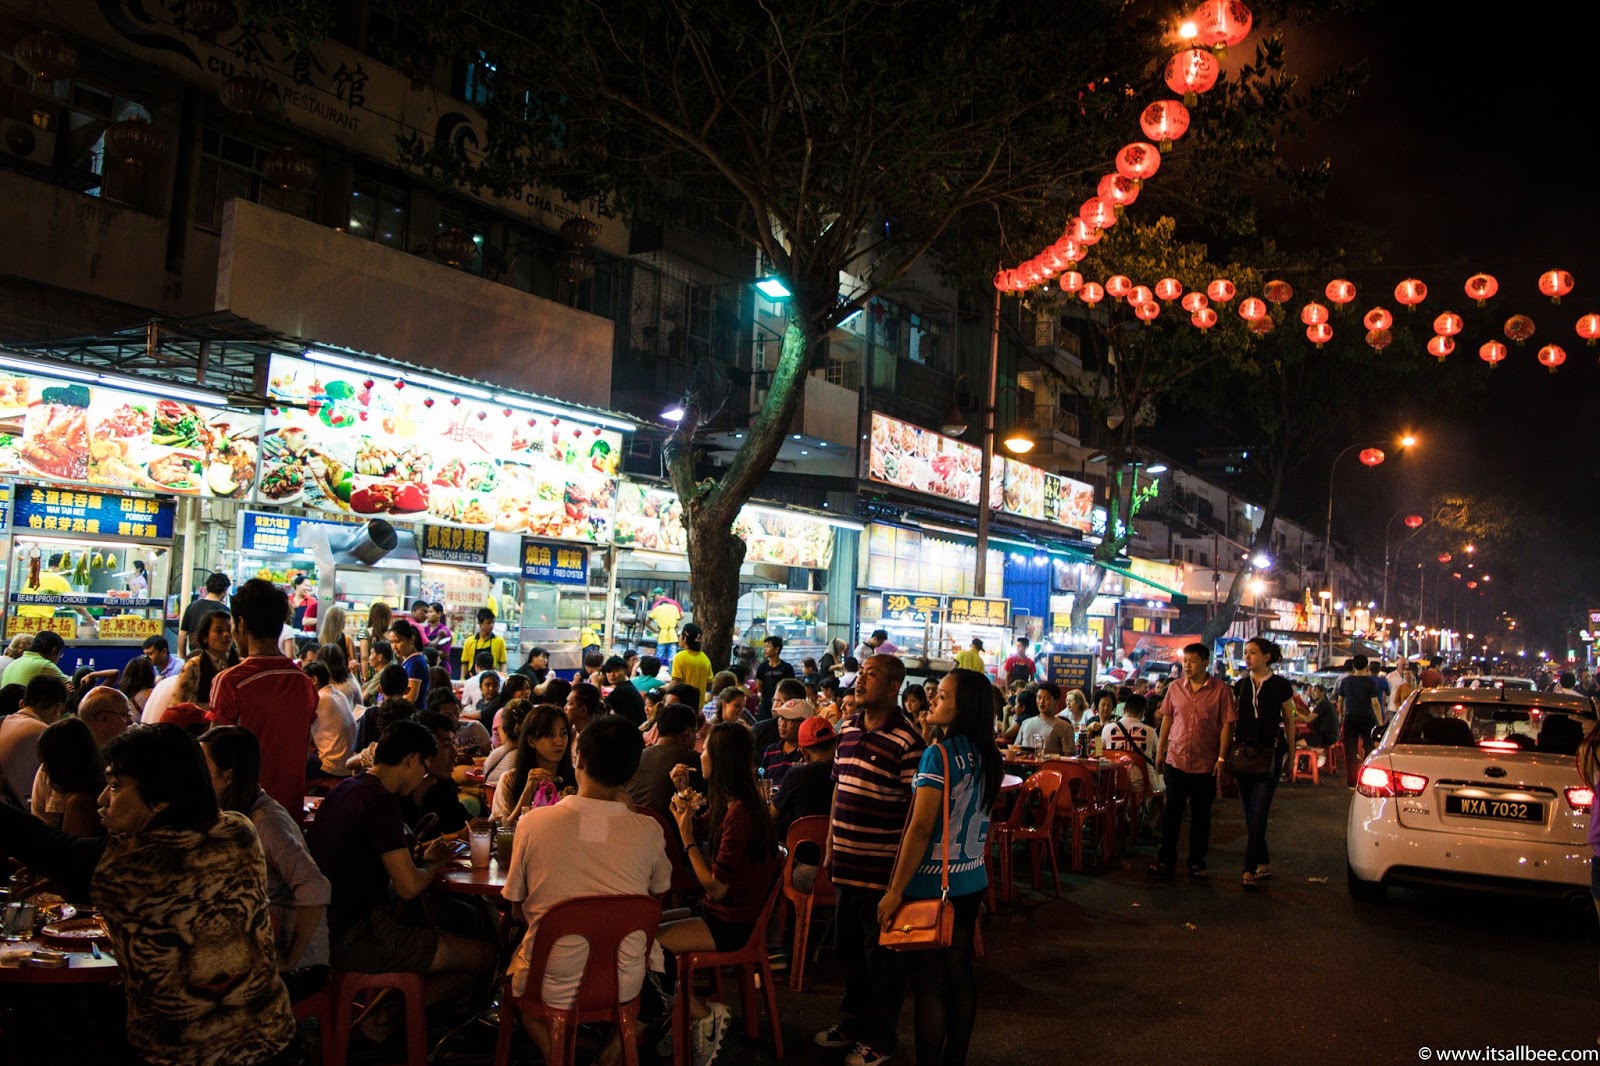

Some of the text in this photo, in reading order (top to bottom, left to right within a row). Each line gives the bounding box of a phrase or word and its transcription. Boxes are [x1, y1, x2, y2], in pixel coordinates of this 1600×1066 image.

[284, 87, 361, 131] RESTAURANT
[526, 194, 552, 214] CHA
[47, 505, 86, 517] WAN TAN MEE
[125, 513, 153, 522] PORRIDGE
[426, 548, 445, 560] PENANG
[446, 551, 458, 561] CHAR
[526, 566, 550, 576] GRILL FISH
[553, 568, 584, 580] FRIED OYSTER
[17, 594, 87, 604] BEAN SPROUTS CHICKEN
[103, 597, 119, 605] KUEH
[119, 598, 135, 606] TEOW
[1461, 798, 1528, 819] WXA 7032
